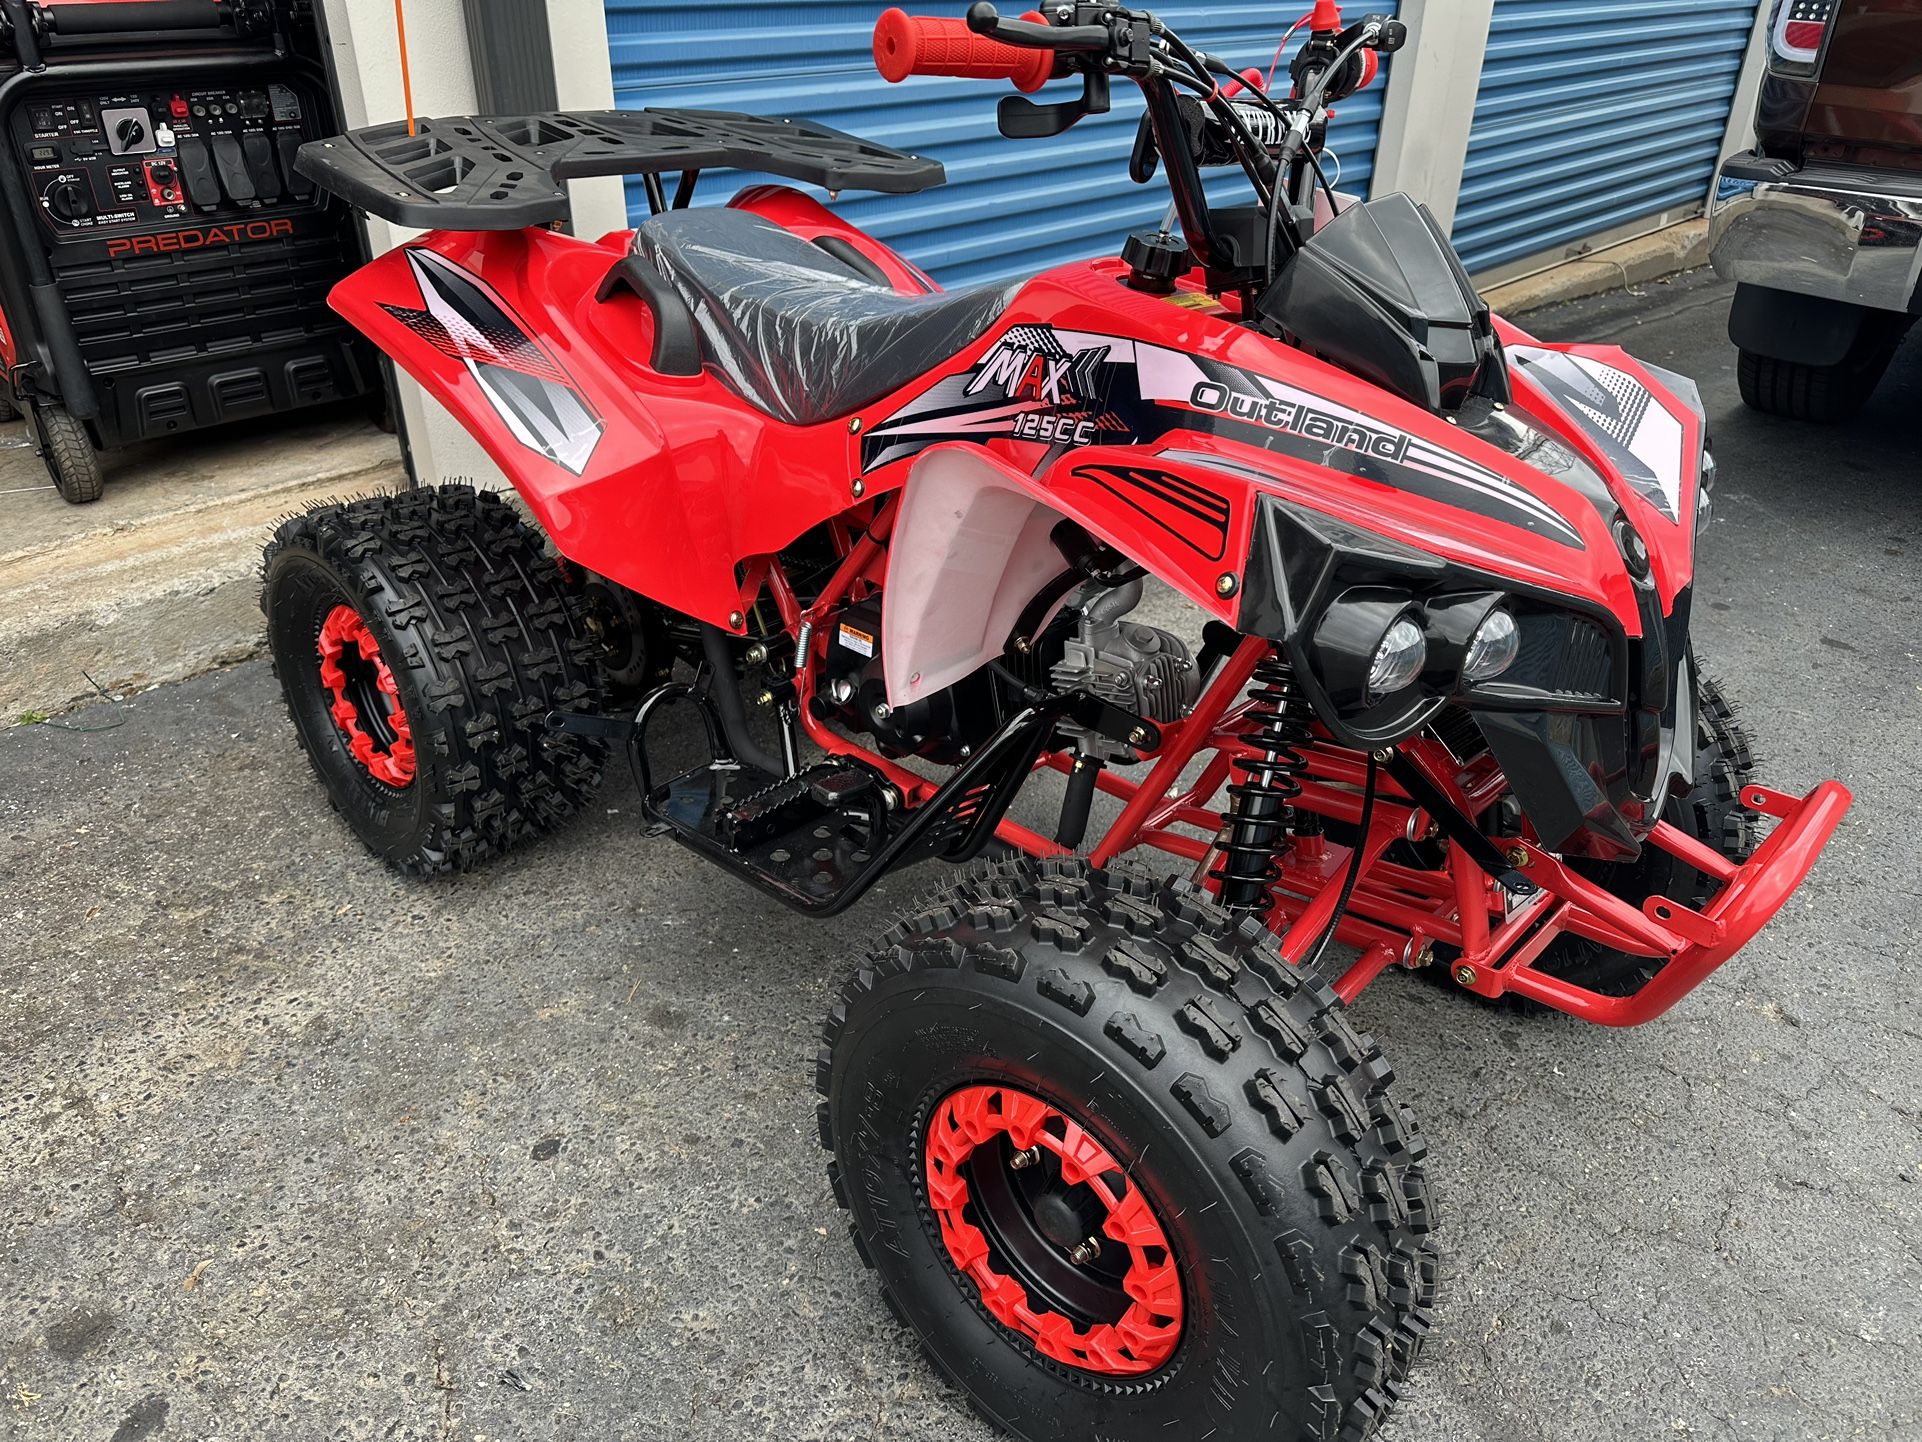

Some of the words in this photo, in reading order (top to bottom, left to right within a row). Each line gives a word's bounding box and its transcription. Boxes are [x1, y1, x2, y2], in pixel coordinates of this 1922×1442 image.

[96, 212, 135, 221] MULTI-SWITCH
[106, 219, 294, 258] PREDATOR
[964, 345, 1072, 404] MAX
[1011, 411, 1095, 446] 125CC
[1188, 380, 1412, 464] Outland
